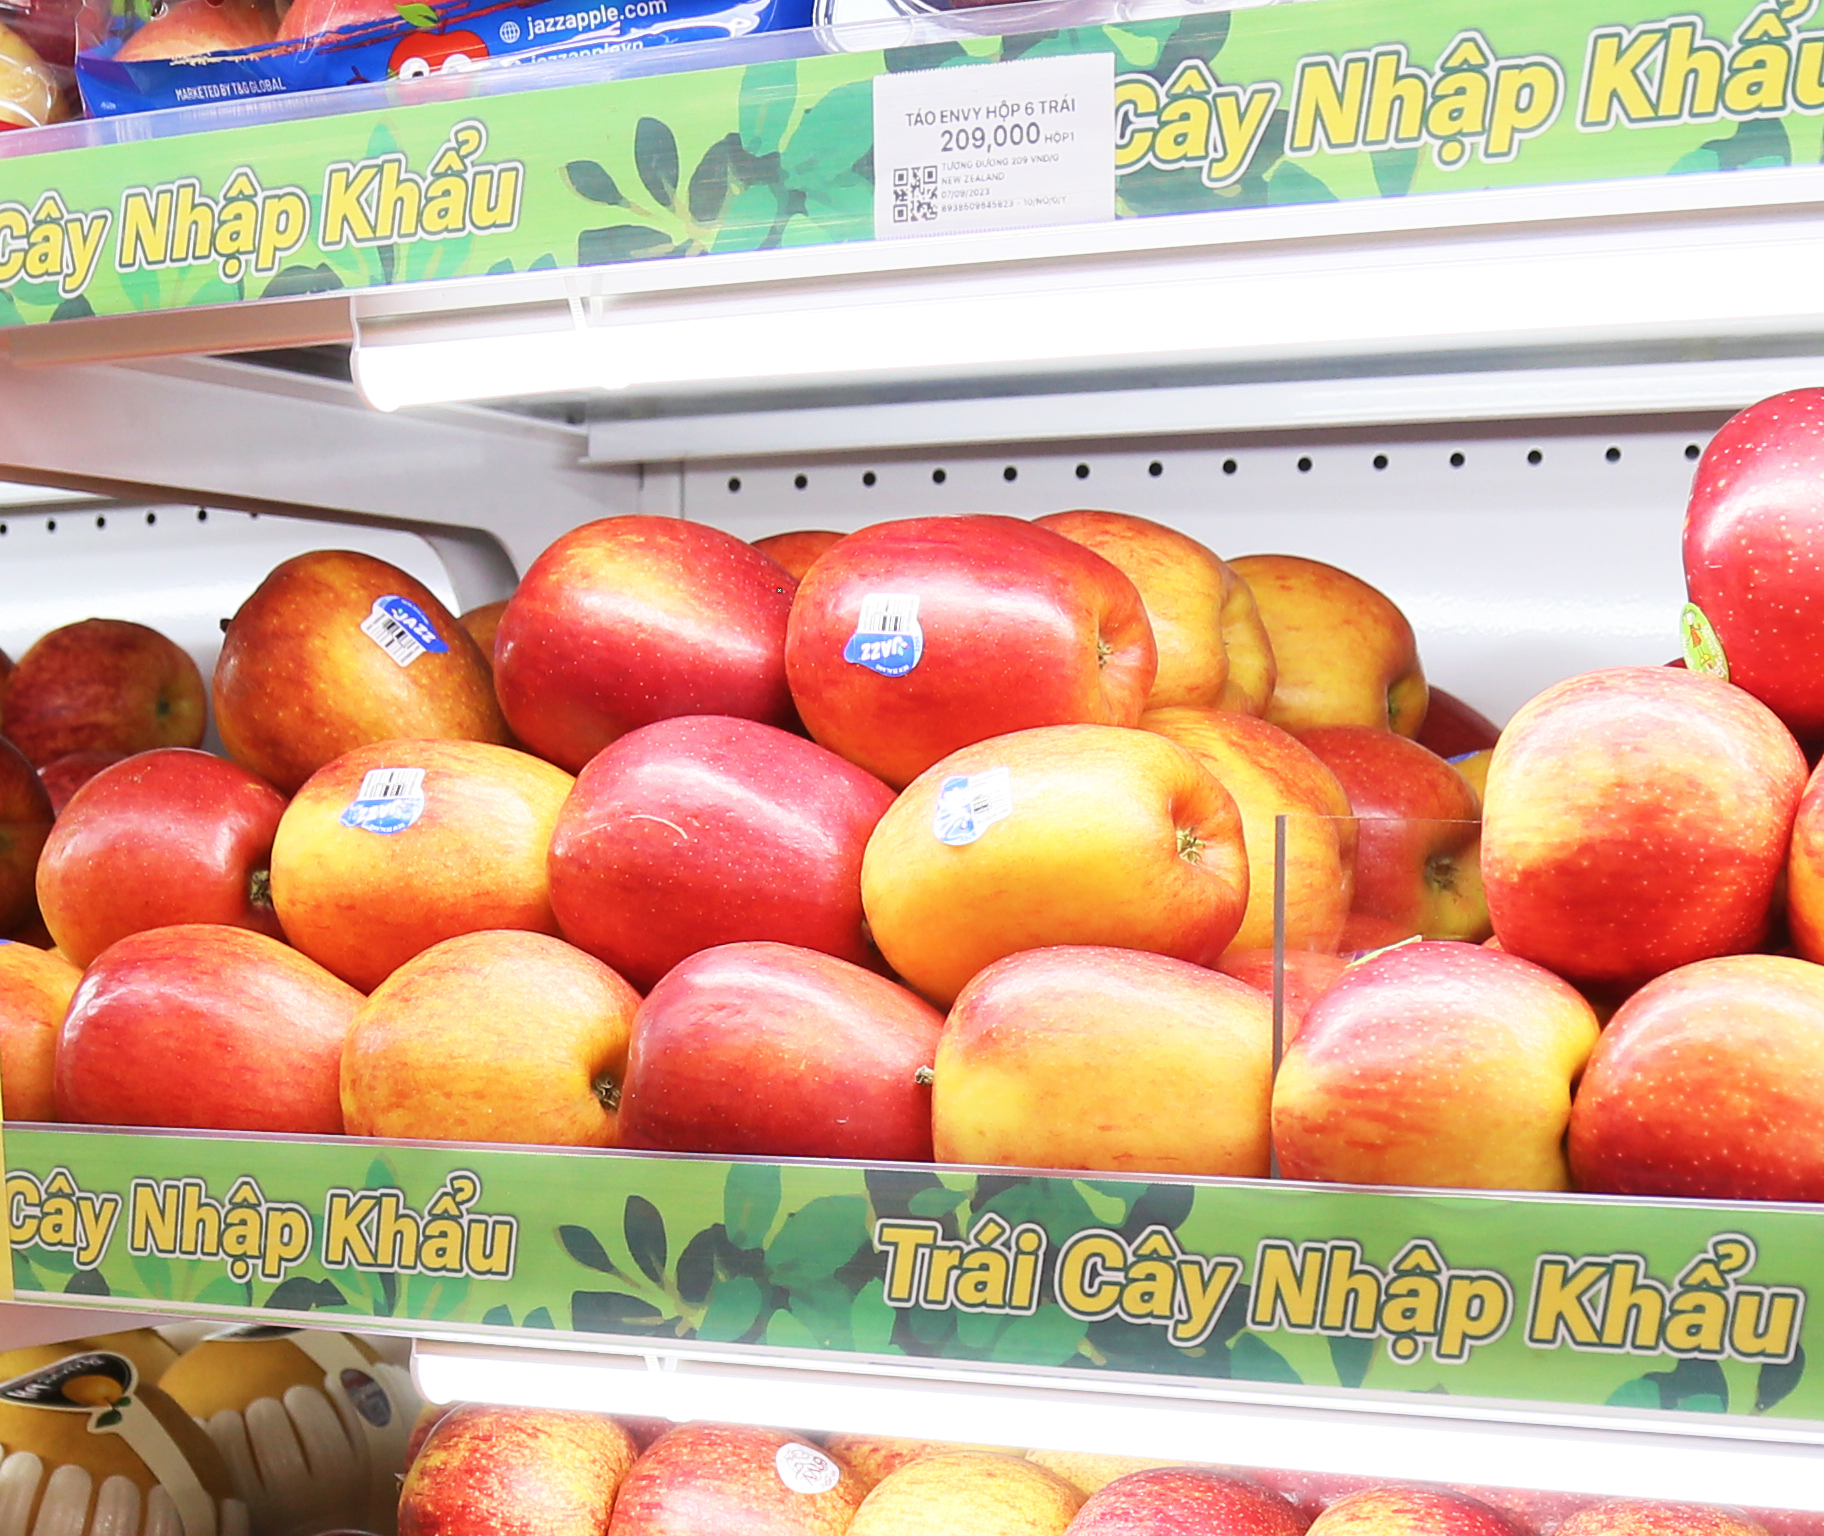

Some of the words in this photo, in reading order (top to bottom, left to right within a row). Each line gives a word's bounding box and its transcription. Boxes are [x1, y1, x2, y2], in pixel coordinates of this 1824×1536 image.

[526, 0, 667, 39] jazzapple.com
[176, 84, 218, 100] MARKETED
[220, 83, 230, 97] BY
[232, 81, 249, 95] T&G
[251, 78, 285, 93] GLOBAL
[906, 107, 936, 127] TÁO
[940, 107, 981, 124] ENVY
[986, 100, 1020, 121] HỘP
[1025, 102, 1035, 115] 6
[1039, 94, 1076, 114] TRÁI
[1114, 60, 1281, 187] Cây
[1285, 30, 1564, 170] Nhập
[940, 122, 1041, 153] 209,000
[941, 176, 961, 185] NEW
[964, 172, 1005, 184] ZEALAND
[118, 167, 306, 285] Nhập
[320, 118, 525, 250] Khẩu
[390, 608, 437, 644] JAZZ
[860, 635, 904, 662] JAZZ
[130, 1177, 308, 1283] Nhập
[323, 1170, 518, 1281] Khẩu
[877, 1212, 1040, 1315] Trái
[1059, 1220, 1242, 1348] Cây
[1252, 1238, 1515, 1366] Nhập
[1527, 1232, 1805, 1366] Khẩu
